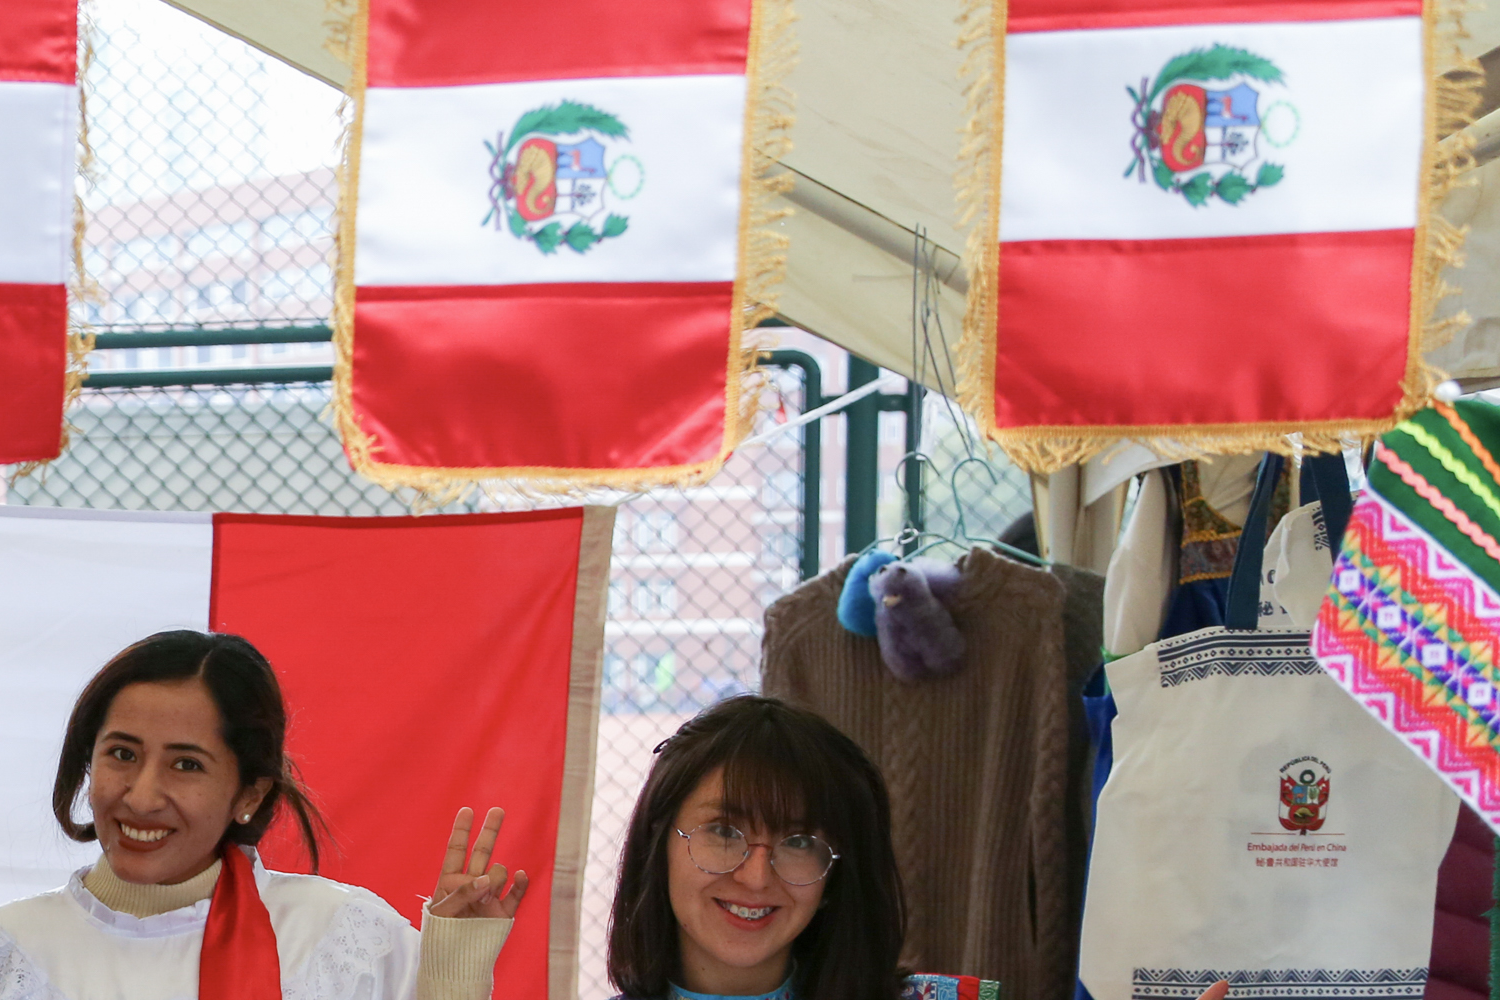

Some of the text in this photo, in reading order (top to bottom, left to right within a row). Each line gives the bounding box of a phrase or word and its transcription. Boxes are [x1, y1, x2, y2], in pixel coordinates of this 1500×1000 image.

[1247, 843, 1288, 853] Embajada
[1289, 843, 1300, 852] del
[1327, 843, 1347, 852] China
